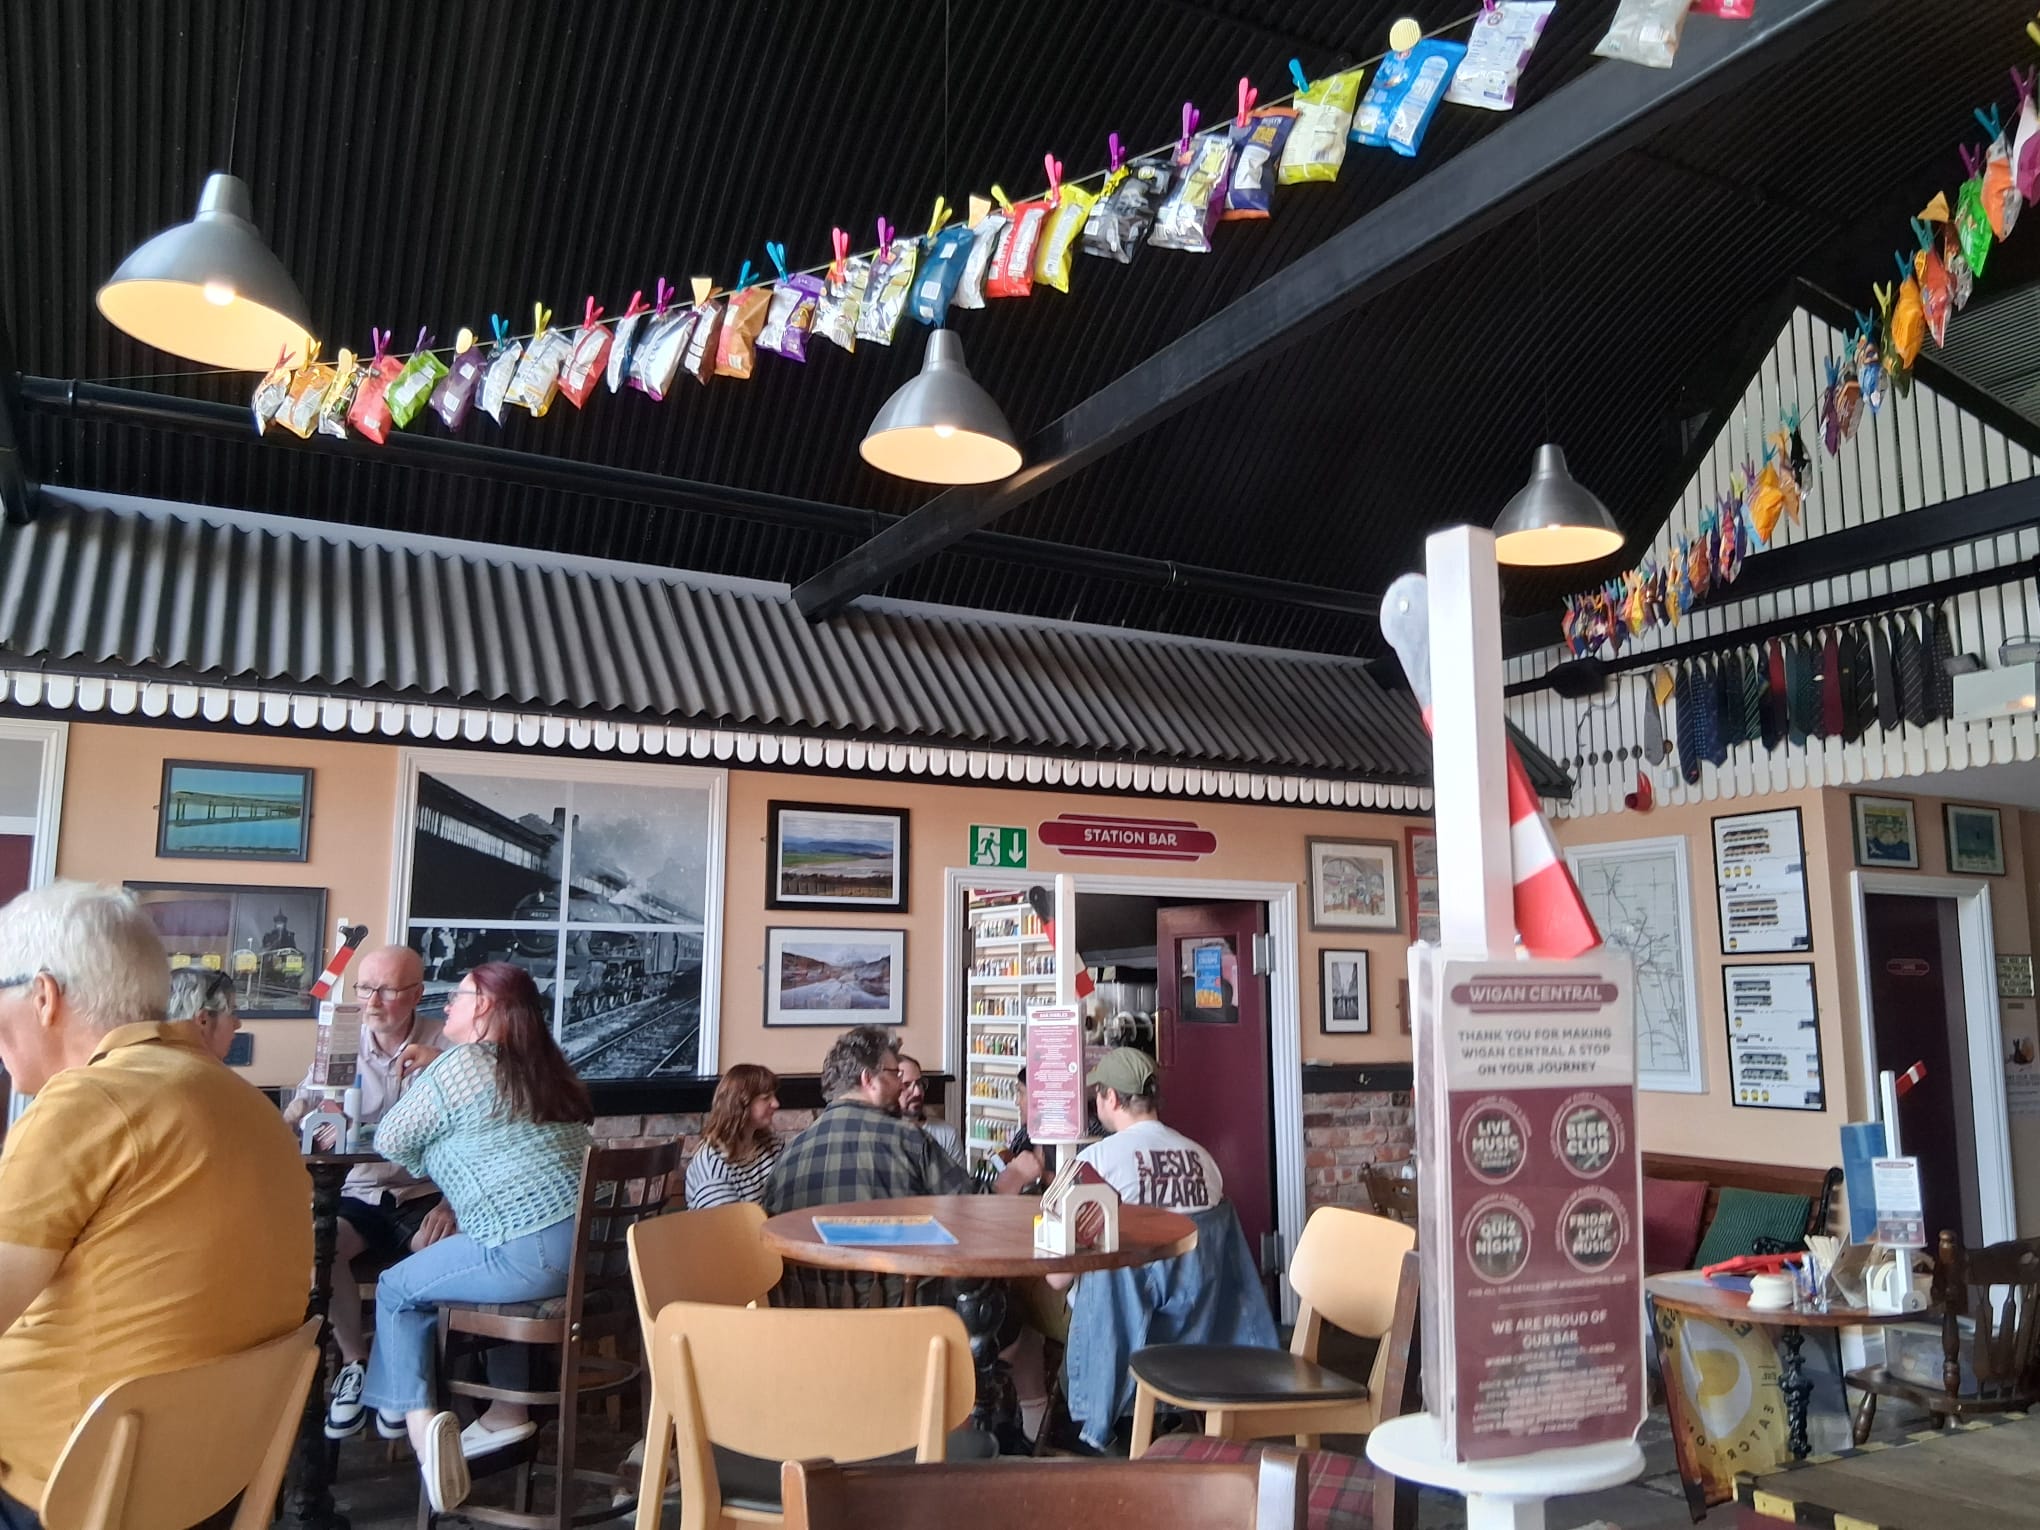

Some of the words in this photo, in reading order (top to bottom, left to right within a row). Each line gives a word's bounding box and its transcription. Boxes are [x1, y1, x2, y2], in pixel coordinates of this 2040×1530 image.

[1084, 828, 1145, 844] STATION
[1148, 832, 1178, 846] BAR
[1469, 986, 1526, 1002] WIGAN
[1529, 985, 1602, 1001] CENTRAL
[1458, 1029, 1501, 1041] THANK
[1506, 1029, 1531, 1041] YOU
[1535, 1028, 1558, 1040] FOR
[1562, 1027, 1612, 1039] MAKING
[1461, 1047, 1505, 1059] WIGAN
[1509, 1045, 1565, 1058] CENTRAL
[1568, 1045, 1576, 1056] A
[1579, 1044, 1610, 1055] STOP
[1478, 1064, 1496, 1075] ON
[1500, 1063, 1533, 1074] YOUR
[1538, 1061, 1596, 1074] JOURNEY
[1478, 1120, 1511, 1136] LIVE
[1566, 1121, 1609, 1139] BEER
[1472, 1137, 1519, 1152] MUSIC
[1567, 1139, 1610, 1156] CLUB
[1149, 1150, 1204, 1177] JESUS
[1138, 1178, 1208, 1207] LIZARD
[1569, 1213, 1614, 1228] FRIDAY
[1480, 1221, 1516, 1237] QUIZ
[1579, 1228, 1606, 1241] LIVE
[1476, 1237, 1523, 1255] NIGHT
[1573, 1240, 1613, 1255] MUSIC
[1491, 1321, 1513, 1335] WE
[1516, 1317, 1540, 1332] ARE
[1544, 1312, 1588, 1330] PROUD
[1590, 1309, 1608, 1324] OF
[1522, 1335, 1550, 1349] OUR
[1553, 1330, 1579, 1345] BAR
